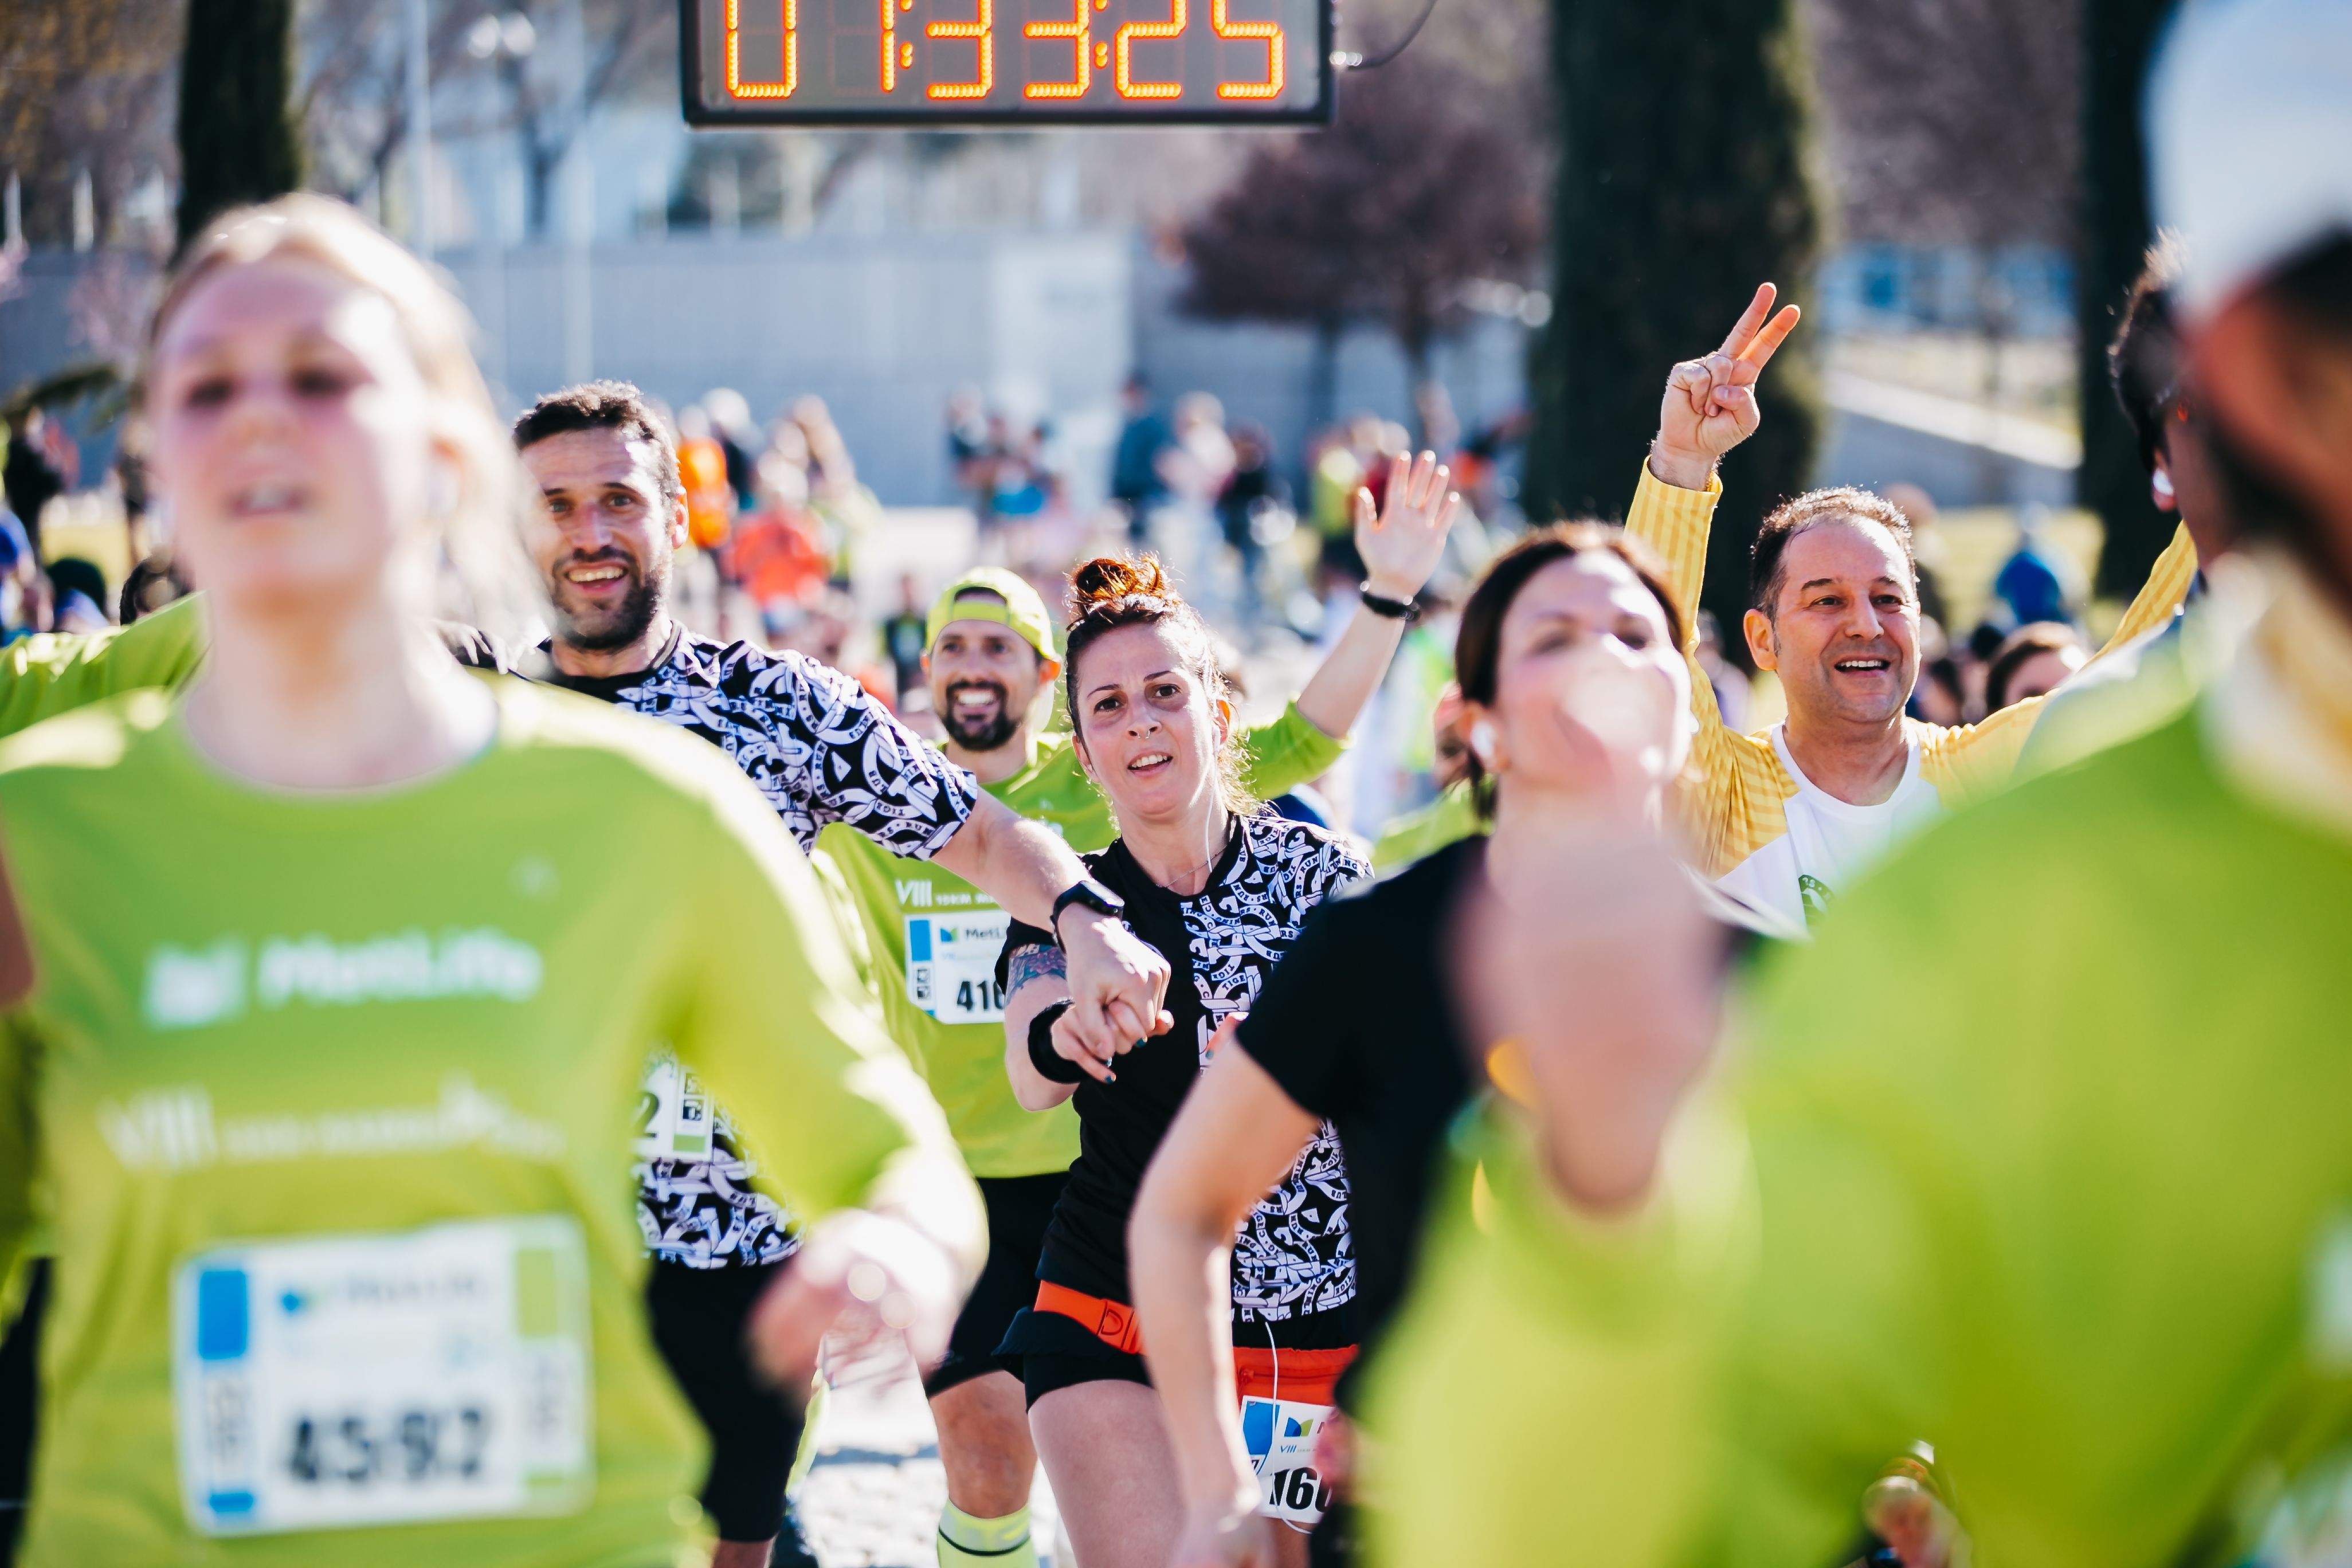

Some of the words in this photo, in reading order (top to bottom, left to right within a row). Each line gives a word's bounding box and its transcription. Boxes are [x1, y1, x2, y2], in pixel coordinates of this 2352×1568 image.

[1300, 856, 1319, 874] RUN
[895, 879, 932, 907] VIII
[1259, 908, 1277, 927] RUN
[965, 927, 1002, 939] MetL
[1222, 974, 1245, 991] TIGE
[1280, 1444, 1297, 1453] VIII
